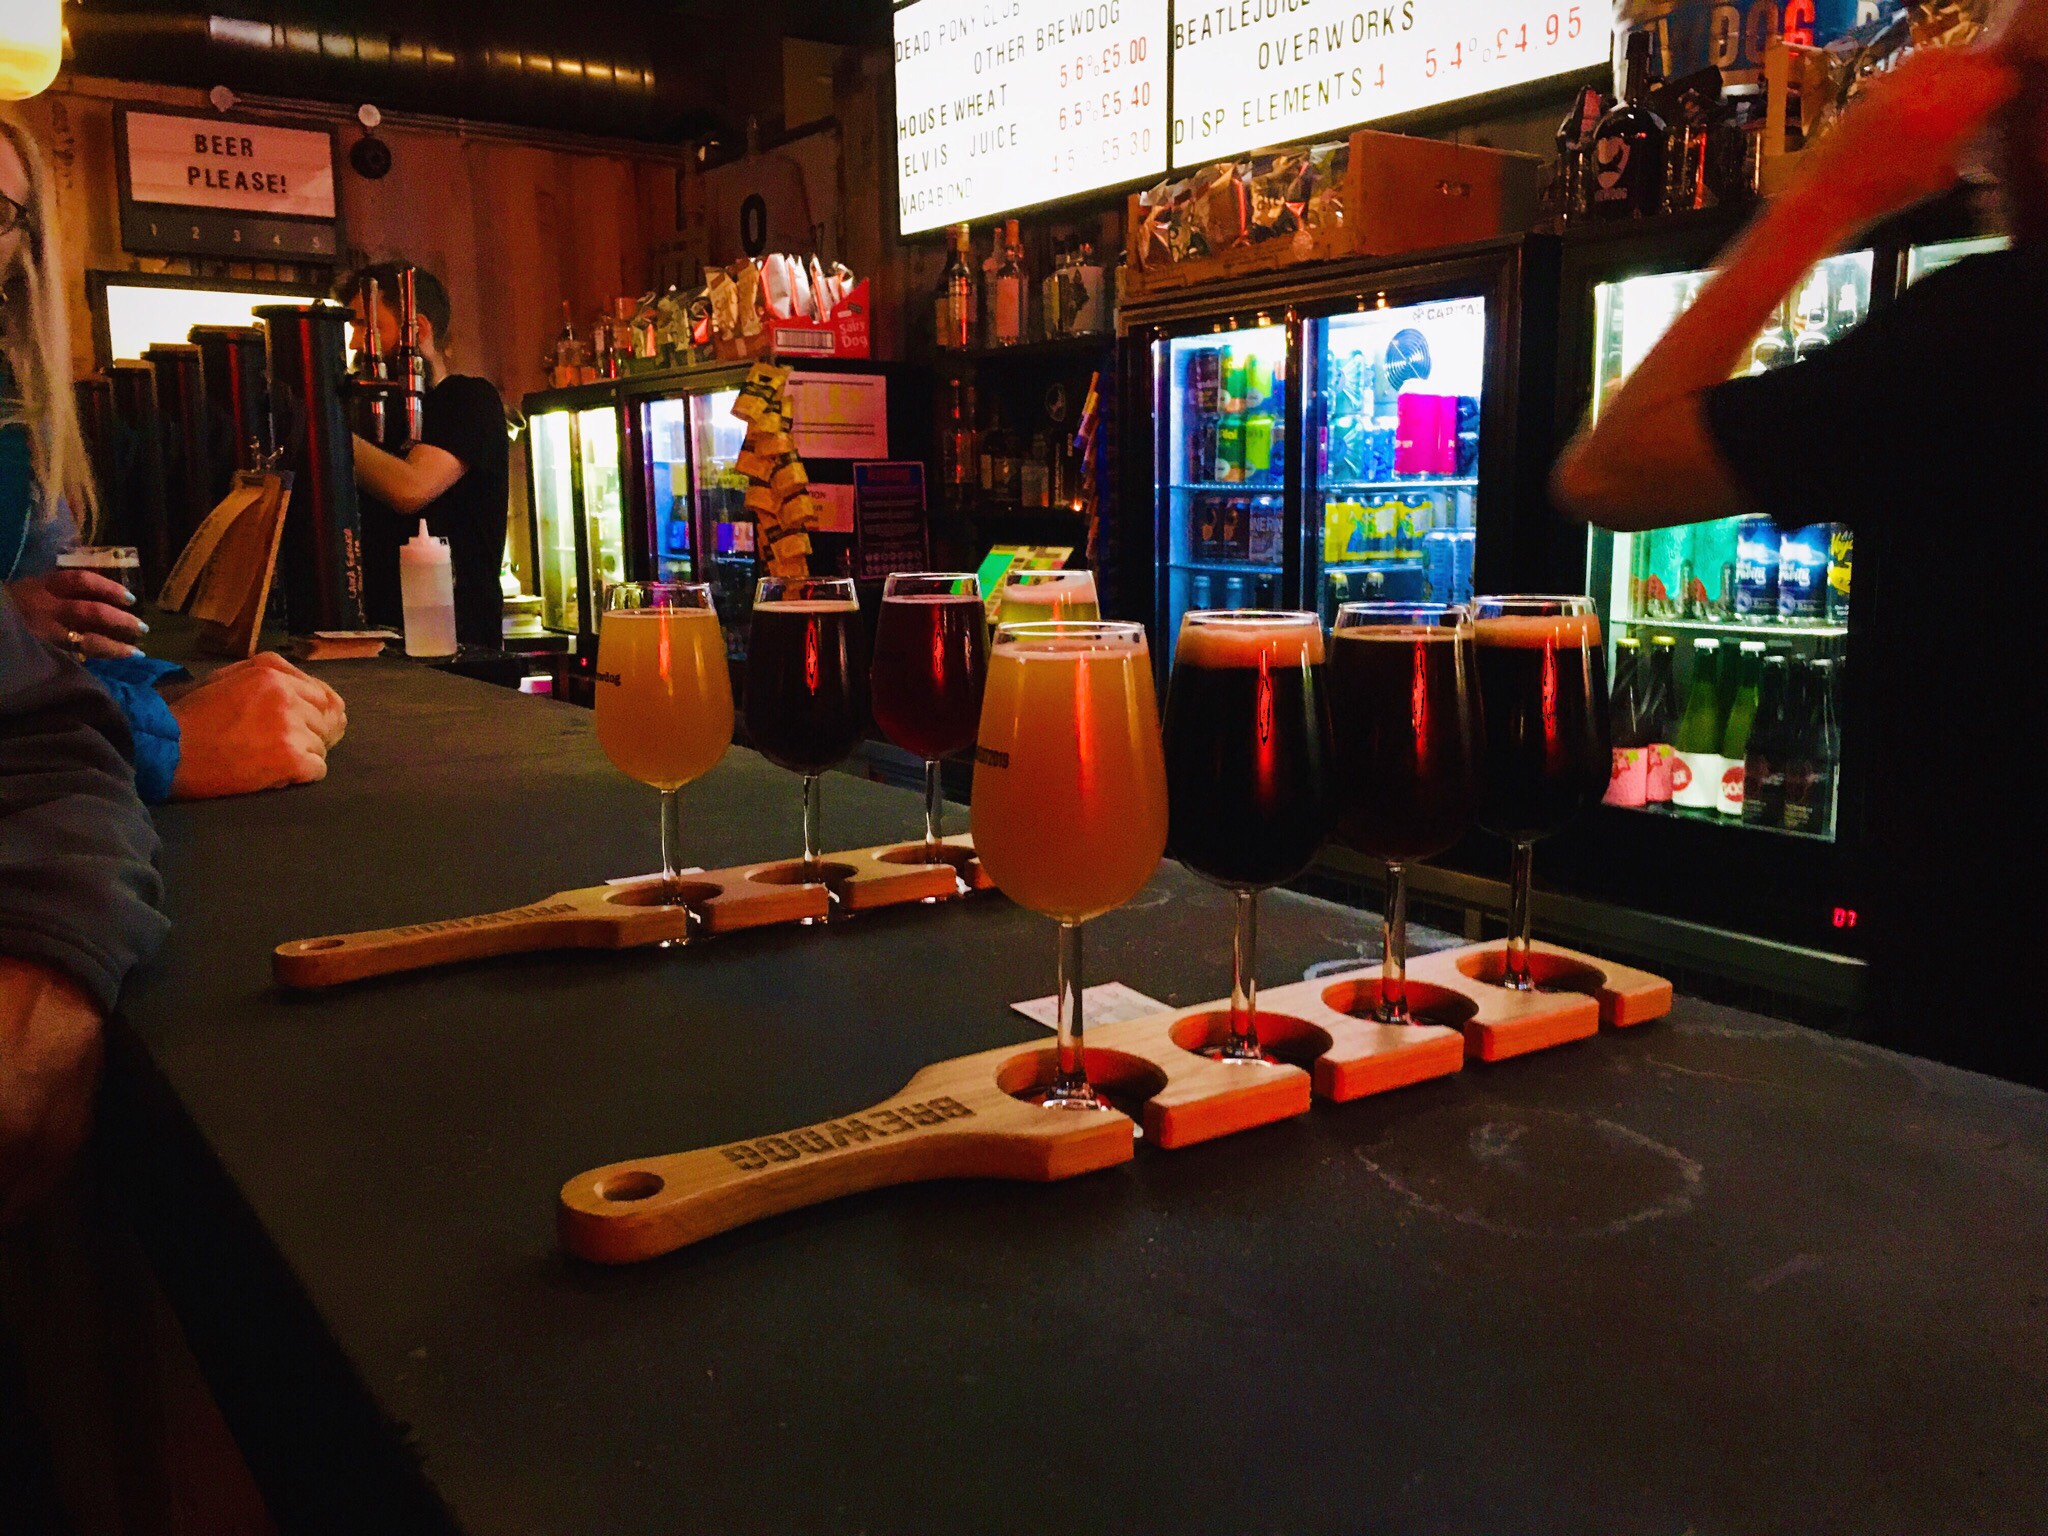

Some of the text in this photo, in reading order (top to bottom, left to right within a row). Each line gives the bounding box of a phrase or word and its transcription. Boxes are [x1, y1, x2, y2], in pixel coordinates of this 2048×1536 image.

[895, 30, 931, 63] DEAD
[939, 14, 976, 46] PONY
[974, 0, 1120, 75] OTHER BREWDOG
[1174, 0, 1311, 50] BEATLEJUIC
[1258, 0, 1414, 70] OVERWORKS
[899, 104, 947, 141] HOUSE
[953, 83, 1007, 121] WHEAT
[1174, 108, 1225, 145] DISP
[1243, 67, 1362, 127] ELEMENTS
[194, 134, 253, 157] BEER
[904, 143, 948, 178] ELVIS
[969, 123, 1018, 158] JUICE
[187, 166, 288, 194] PLEASE!
[901, 177, 973, 216] VAGABOND
[192, 226, 200, 240] 2
[233, 229, 241, 242] 3
[273, 234, 281, 247] 4
[841, 335, 868, 348] Dog
[720, 1096, 976, 1171] BREWDOG
